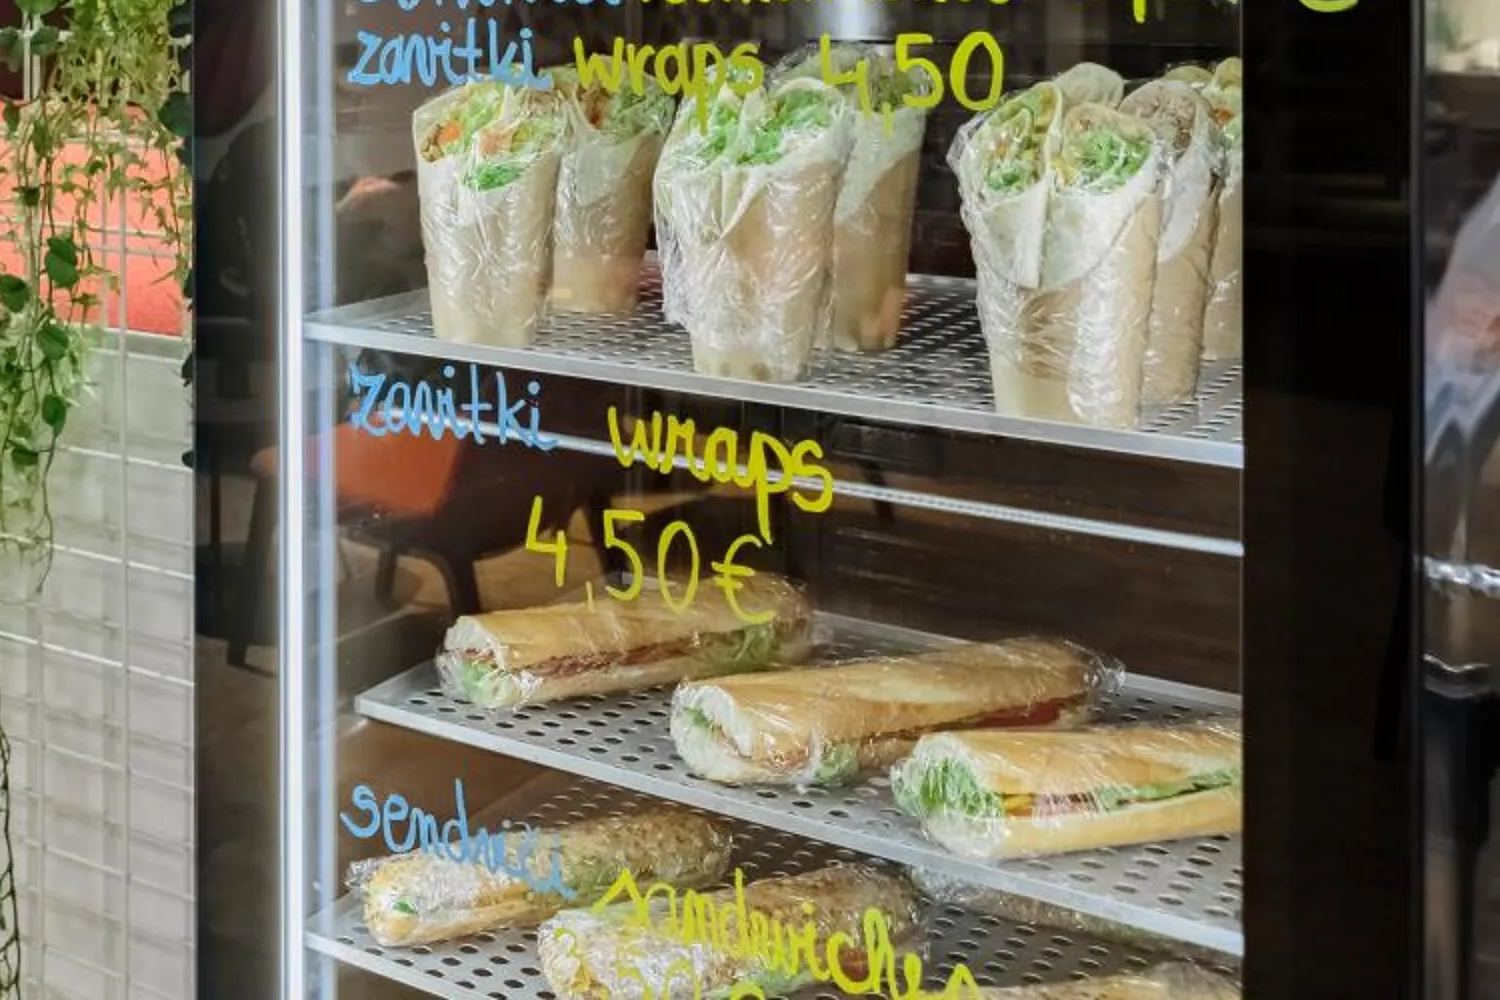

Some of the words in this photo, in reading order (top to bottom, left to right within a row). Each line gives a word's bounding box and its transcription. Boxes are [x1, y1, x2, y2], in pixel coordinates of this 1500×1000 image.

[348, 17, 553, 87] zavitki
[573, 34, 768, 137] wraps
[818, 30, 1005, 140] 4,50
[348, 362, 560, 452] zavitki
[605, 404, 835, 546] wraps
